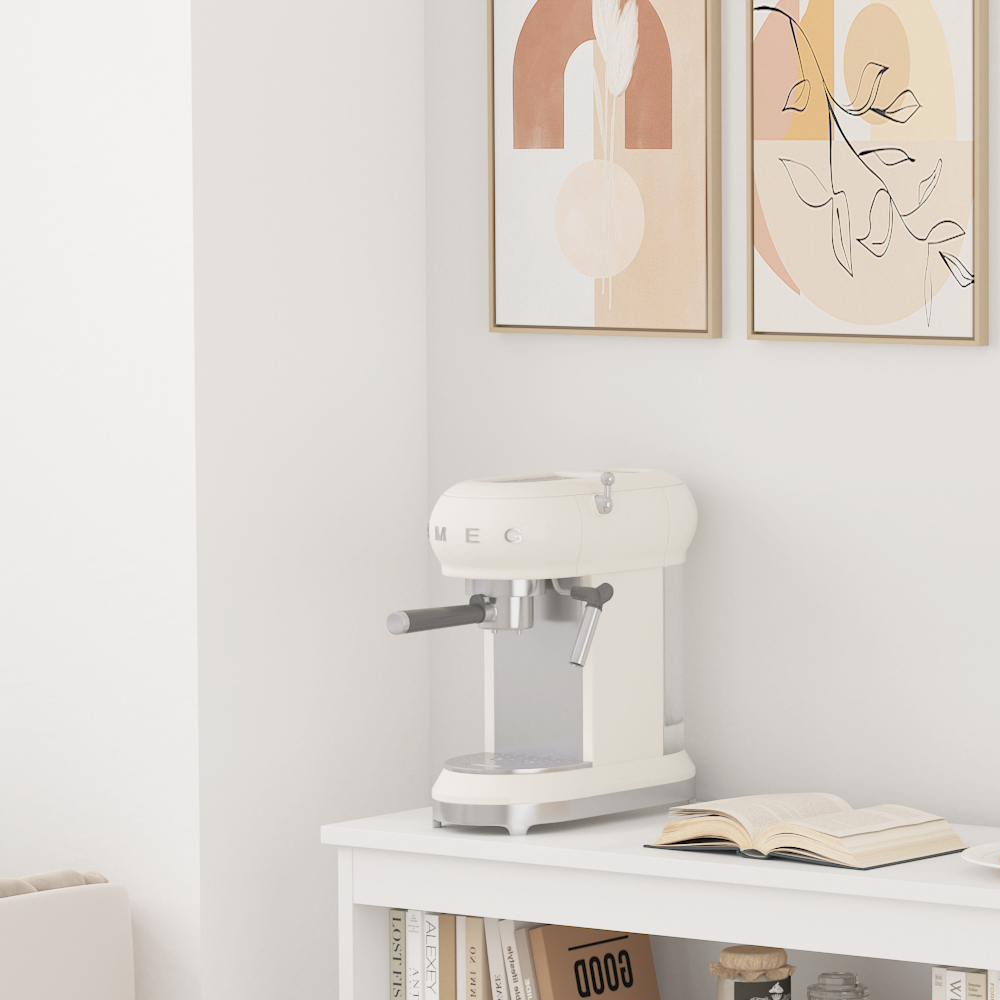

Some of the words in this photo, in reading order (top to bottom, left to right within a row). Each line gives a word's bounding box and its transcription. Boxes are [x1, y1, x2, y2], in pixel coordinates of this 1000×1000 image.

[427, 523, 522, 544] MEG
[392, 916, 402, 965] LOST
[426, 921, 437, 994] ALEXEY
